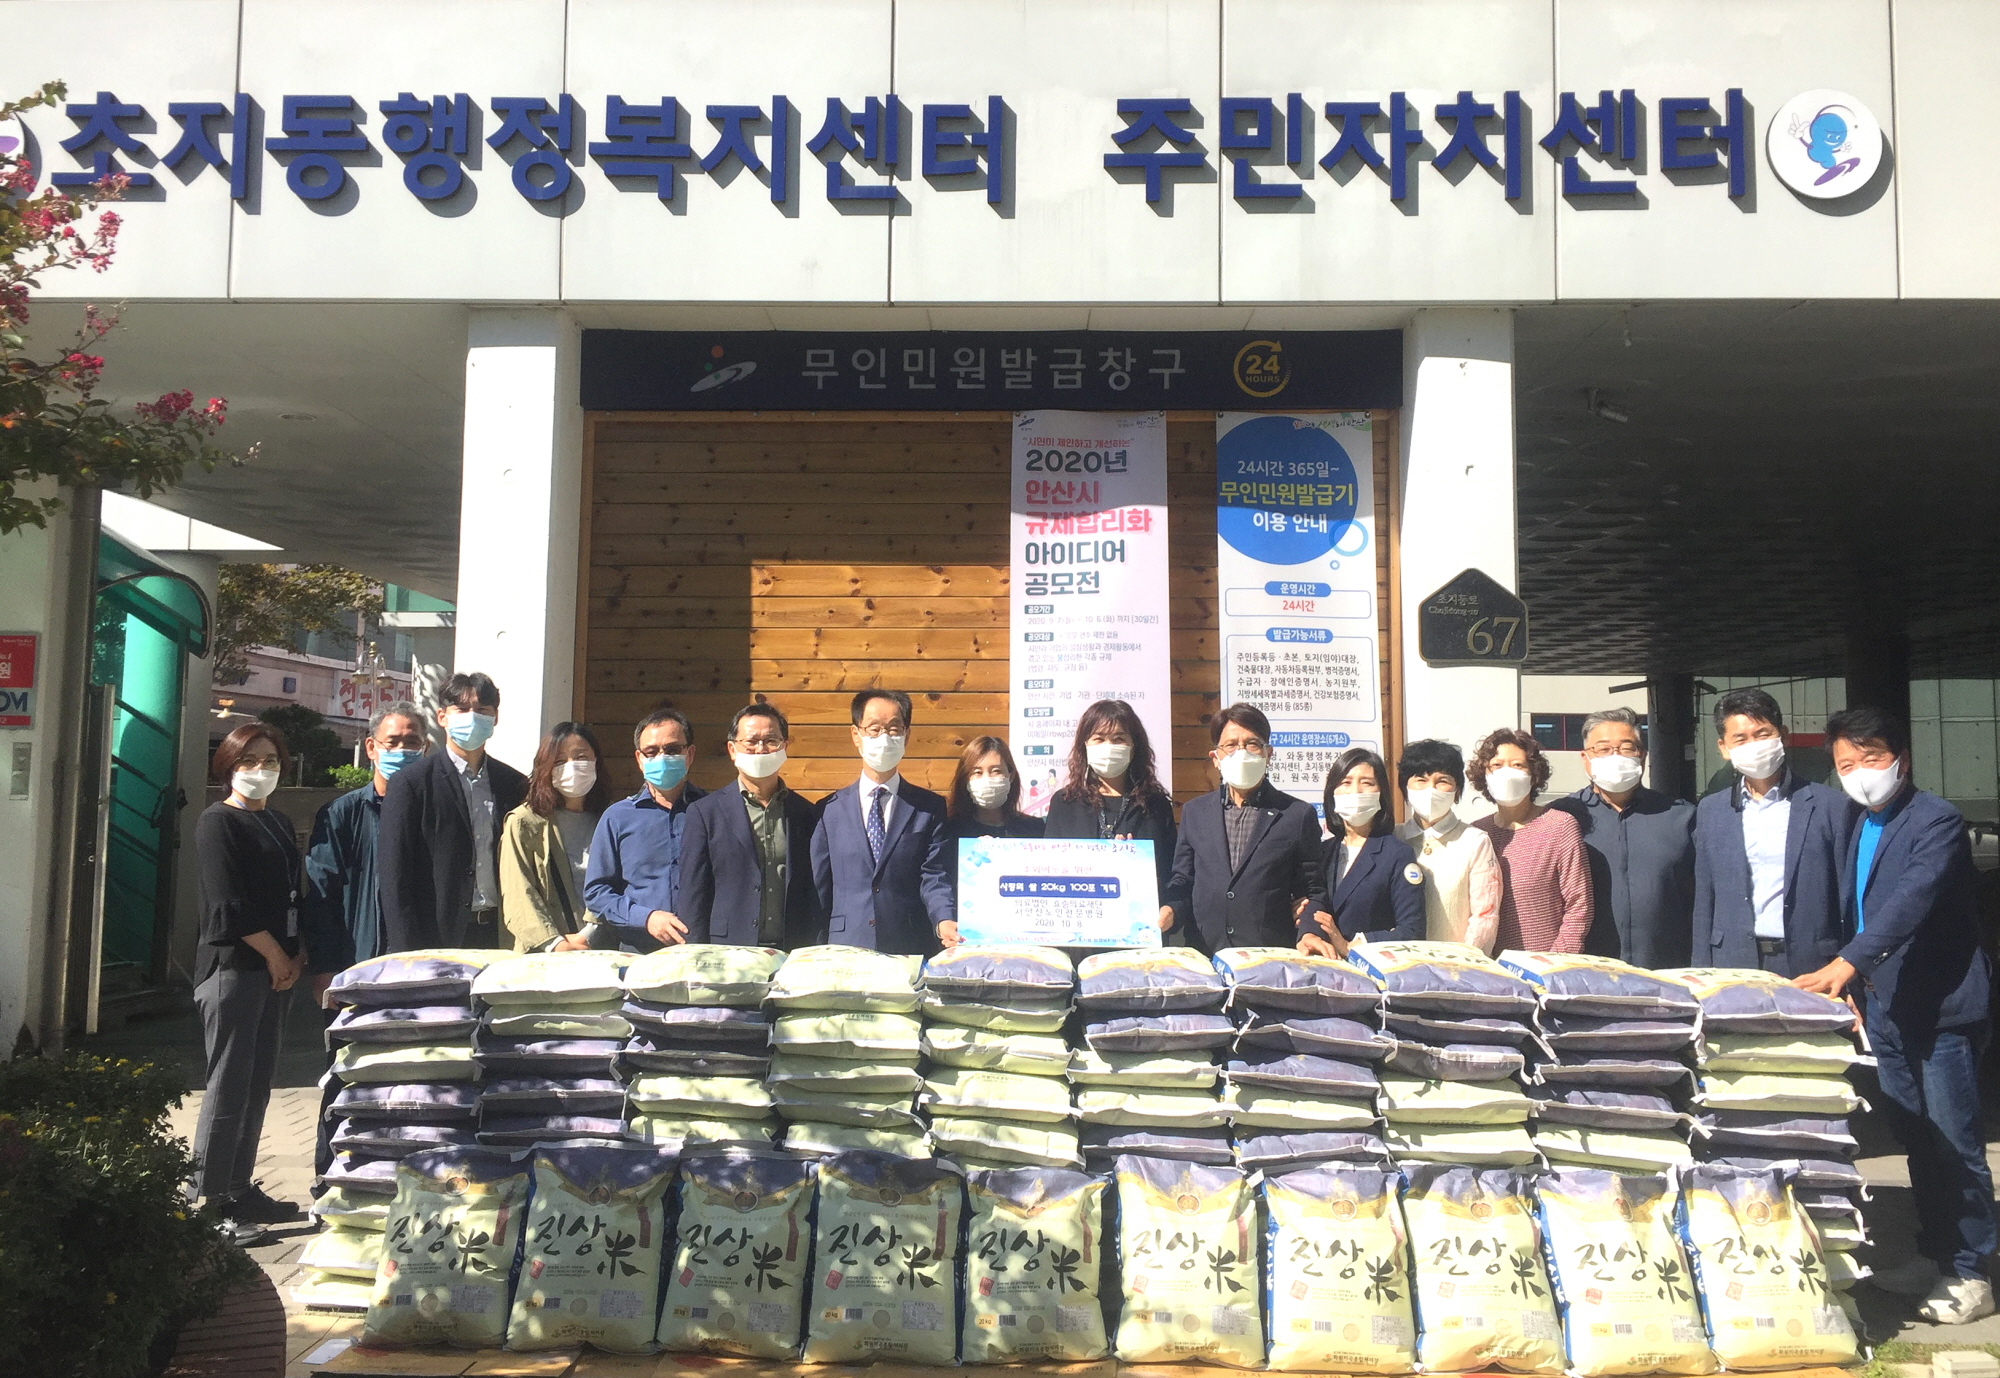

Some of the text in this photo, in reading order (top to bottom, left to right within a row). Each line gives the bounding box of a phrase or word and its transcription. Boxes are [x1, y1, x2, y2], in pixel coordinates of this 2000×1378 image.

[51, 88, 1744, 205] 초지동행정복지센터 주민자치센터
[802, 347, 1186, 391] 무인민원발급창구
[1246, 354, 1280, 375] 24
[1245, 375, 1280, 383] HOURS
[1057, 439, 1092, 449] 제안하고
[1025, 449, 1127, 474] 2020년
[1238, 460, 1340, 478] 24시간 365일~
[1025, 480, 1100, 505] 안산시
[1219, 481, 1353, 507] 무인민원발급기
[1025, 508, 1152, 535] 규제합리화
[1253, 512, 1328, 534] 이용 안내
[1025, 539, 1125, 566] 아이디어
[1025, 570, 1100, 596] 공모전
[1280, 582, 1316, 595] 운영시간
[1282, 600, 1315, 612] 24시간
[1437, 593, 1479, 606] 초지동로
[1117, 615, 1130, 624] 까지
[1273, 629, 1327, 641] 발급가능서류
[1467, 616, 1521, 656] 67
[1103, 643, 1141, 651] 경제활동에서
[1099, 652, 1112, 661] 규제
[1237, 677, 1261, 687] 수급자
[1095, 691, 1116, 700] 단체에
[1138, 691, 1145, 699] 자
[1284, 702, 1292, 711] 등
[1293, 702, 1313, 711] (85종)
[1279, 733, 1300, 745] 24시간
[1301, 733, 1347, 746] 운영장소(6개소)
[1027, 758, 1047, 767] 안산시
[1291, 772, 1321, 783] 원곡동
[1041, 882, 1066, 893] 20kg
[1069, 882, 1096, 893] 100포
[1015, 899, 1048, 908] 의료법인
